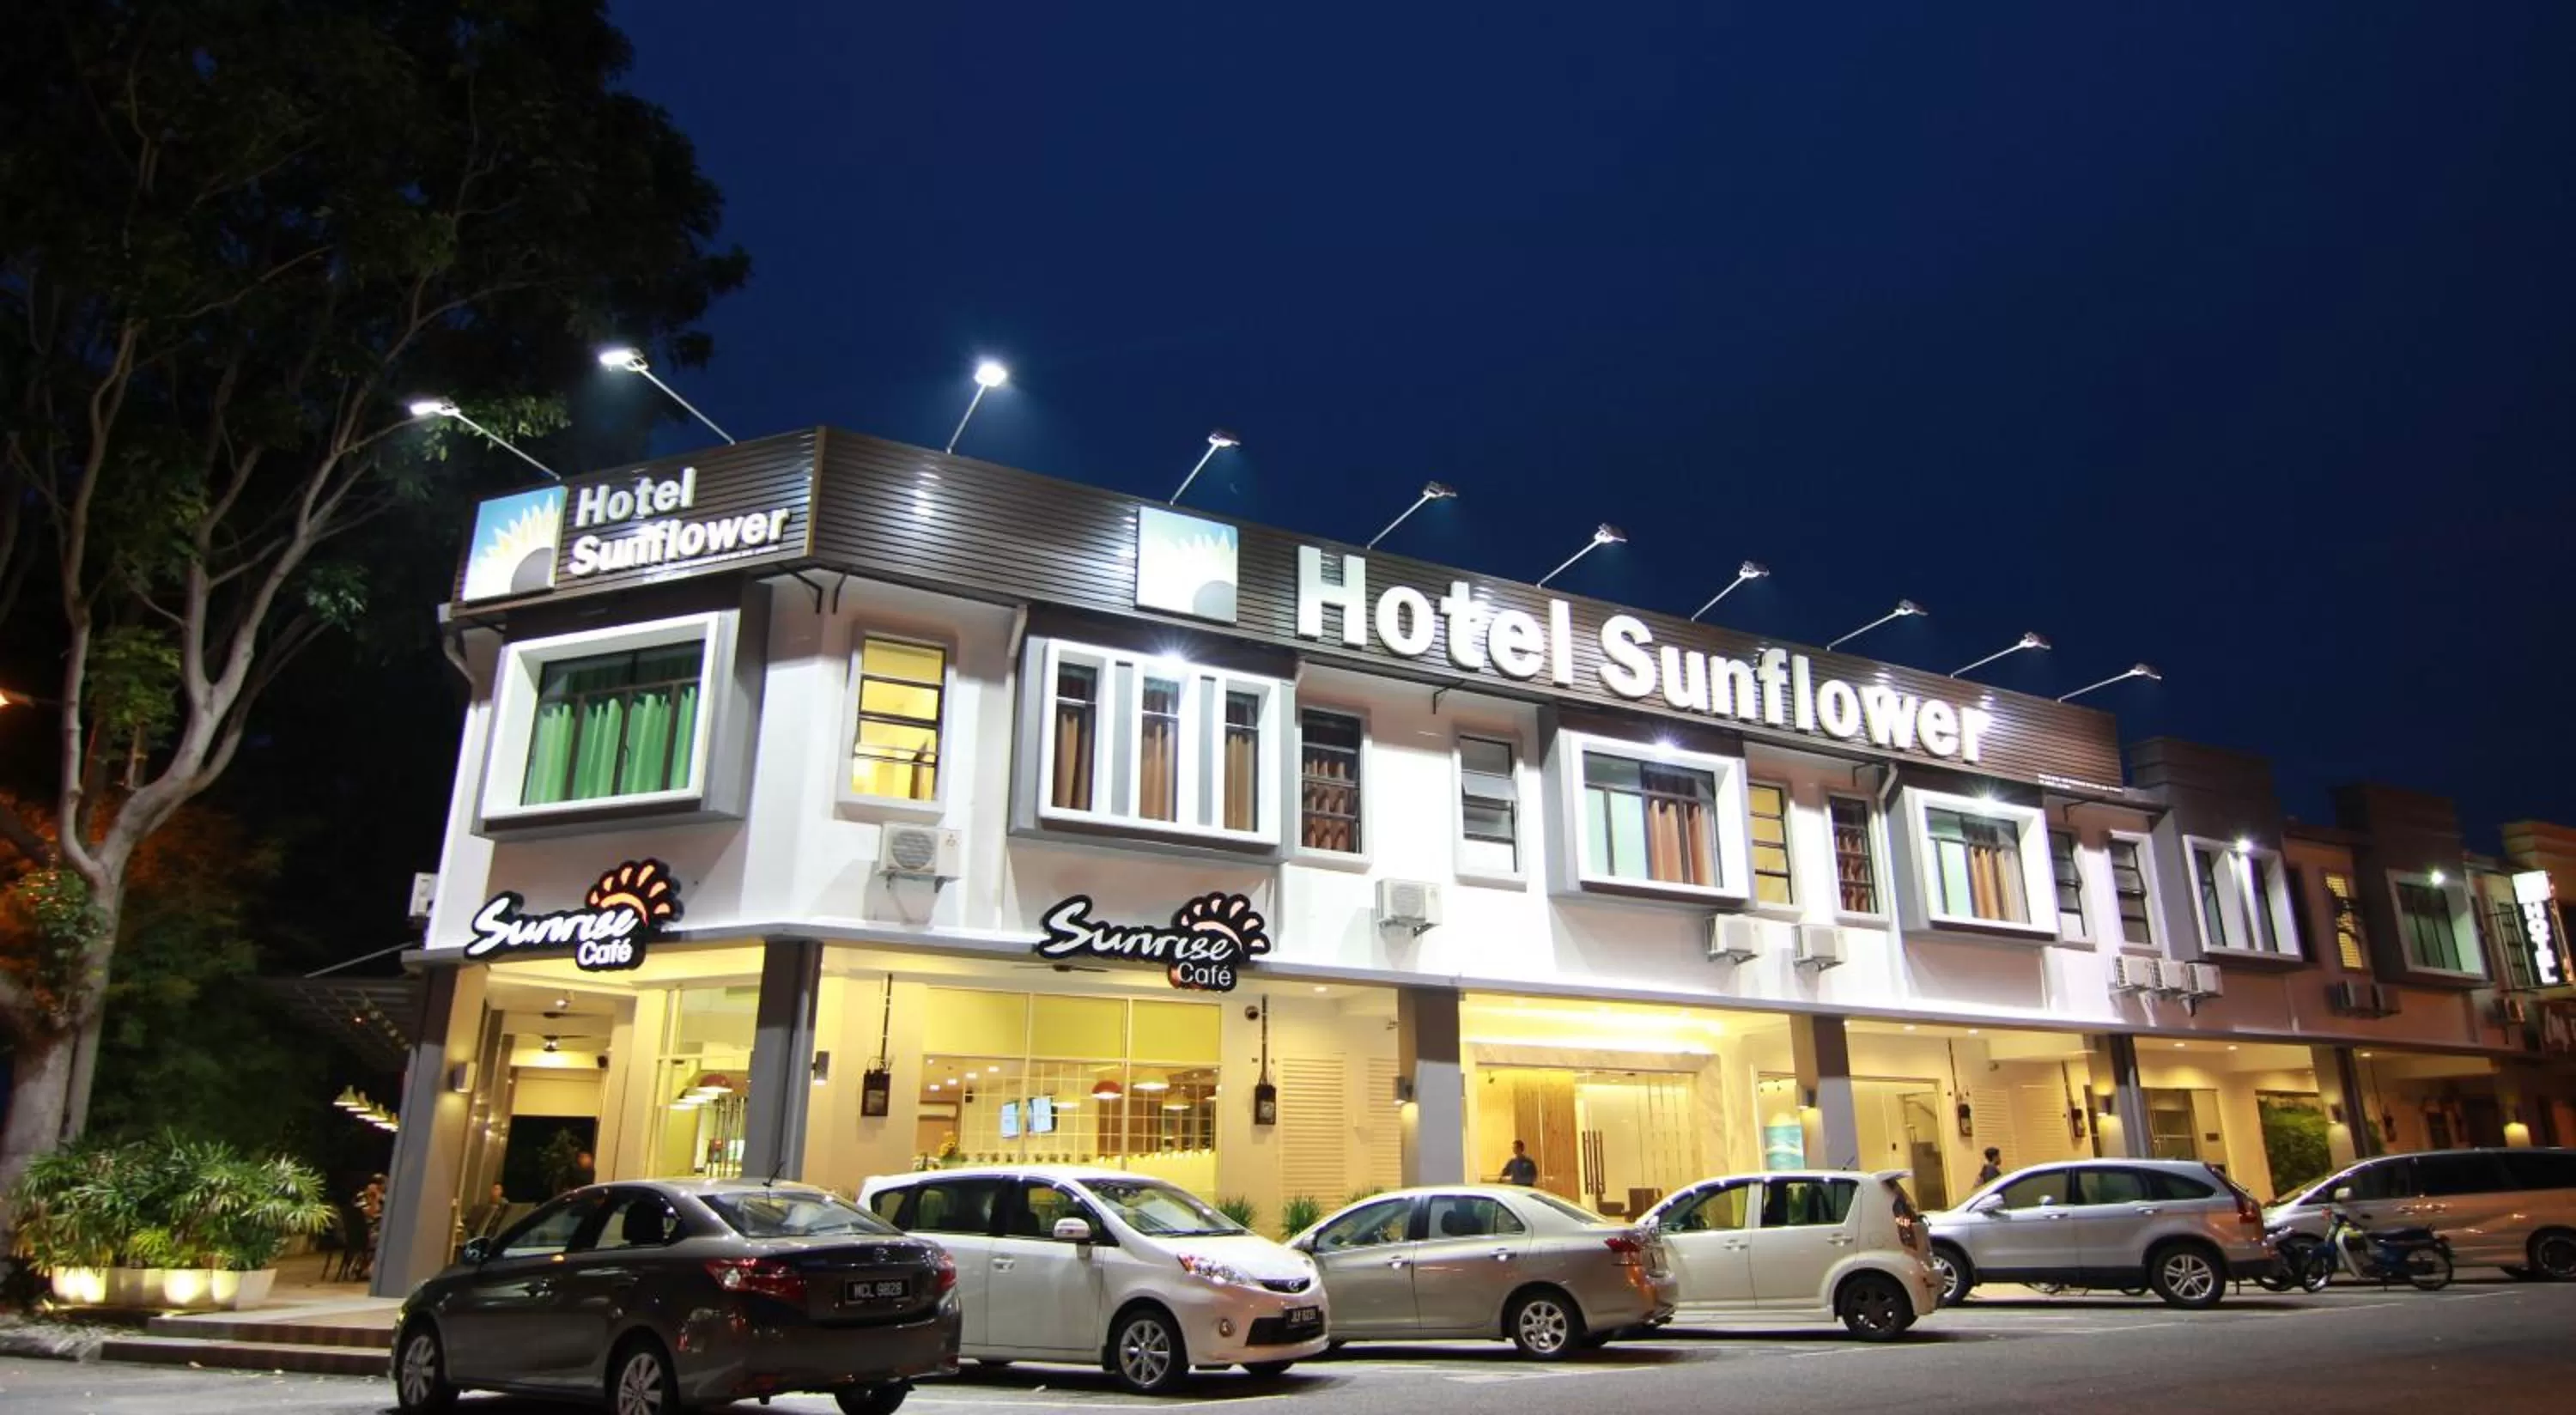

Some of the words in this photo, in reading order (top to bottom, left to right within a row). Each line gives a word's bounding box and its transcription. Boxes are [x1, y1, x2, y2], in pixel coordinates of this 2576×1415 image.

[576, 467, 697, 528] Hotel
[568, 507, 793, 577] Sunflower
[1297, 545, 1573, 687] Hotel
[1597, 615, 1994, 763] Sunflower
[466, 896, 637, 956] Sunrise
[577, 938, 634, 967] Café
[1043, 901, 1233, 961] Sunrise
[2523, 902, 2560, 984] HOTEL
[1176, 962, 1232, 987] Café
